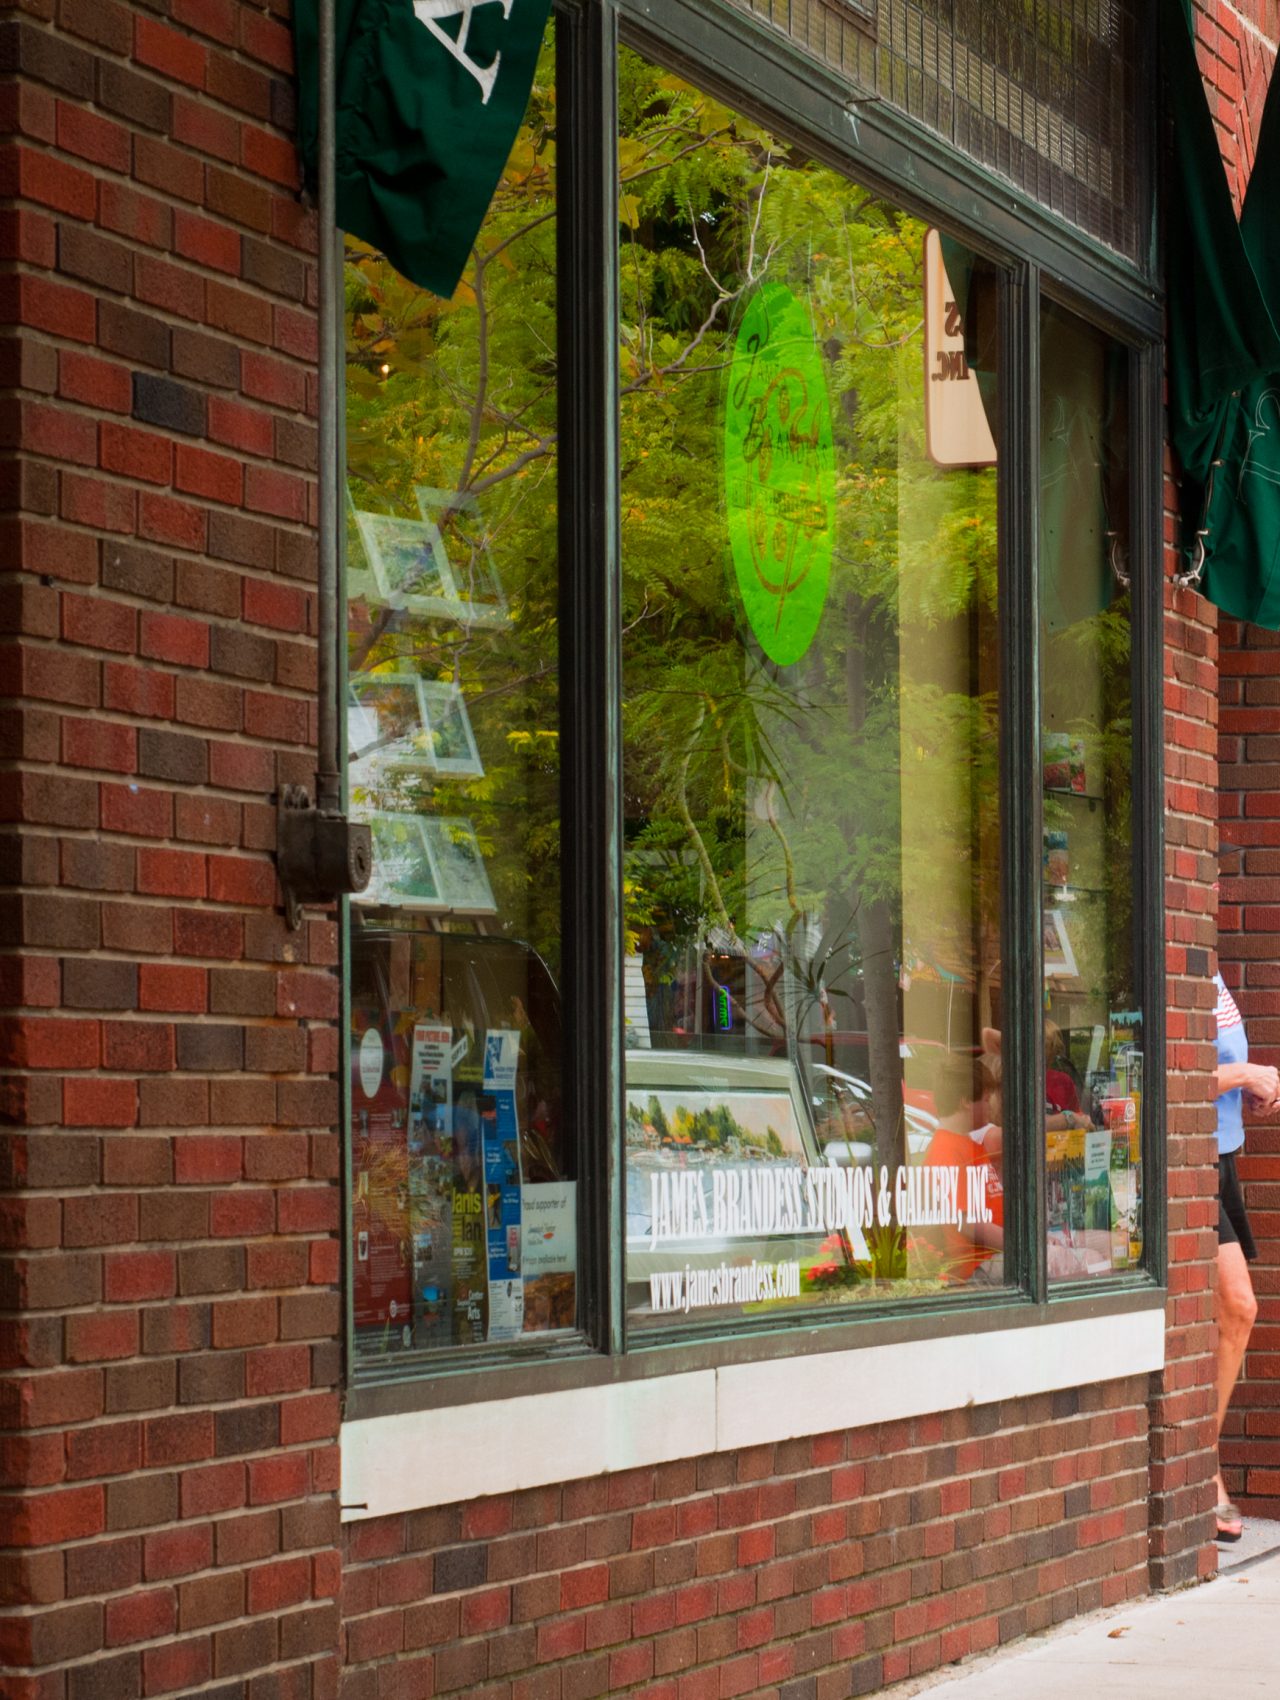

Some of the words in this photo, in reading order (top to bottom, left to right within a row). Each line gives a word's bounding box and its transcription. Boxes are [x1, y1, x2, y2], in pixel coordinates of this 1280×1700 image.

[651, 1170, 710, 1252] JAMES
[713, 1166, 803, 1237] BRANDESS
[877, 1164, 892, 1228] &
[895, 1164, 963, 1232] GALLERY,
[966, 1164, 993, 1224] INC.
[650, 1259, 801, 1314] www.jamesbrandess.com
